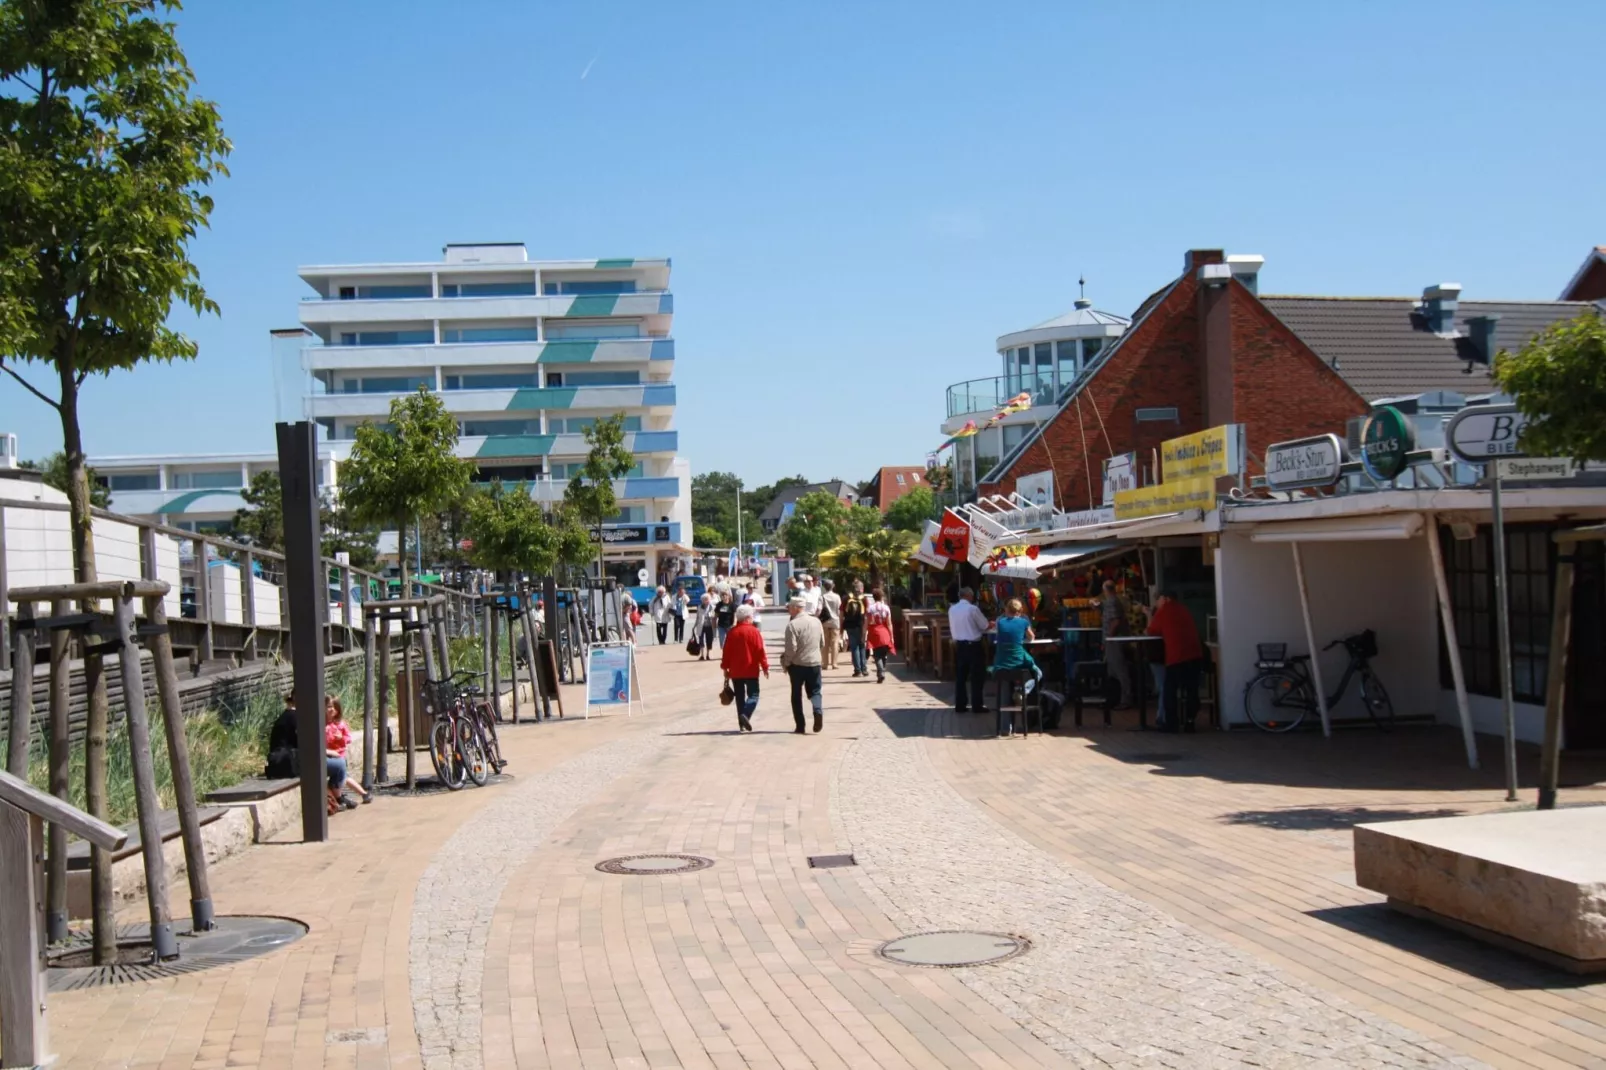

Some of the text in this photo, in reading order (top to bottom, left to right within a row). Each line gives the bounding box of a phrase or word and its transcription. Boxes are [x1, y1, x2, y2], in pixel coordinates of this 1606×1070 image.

[1490, 415, 1530, 442] Be
[1487, 442, 1517, 454] BIE
[1508, 462, 1566, 477] Stephanweg
